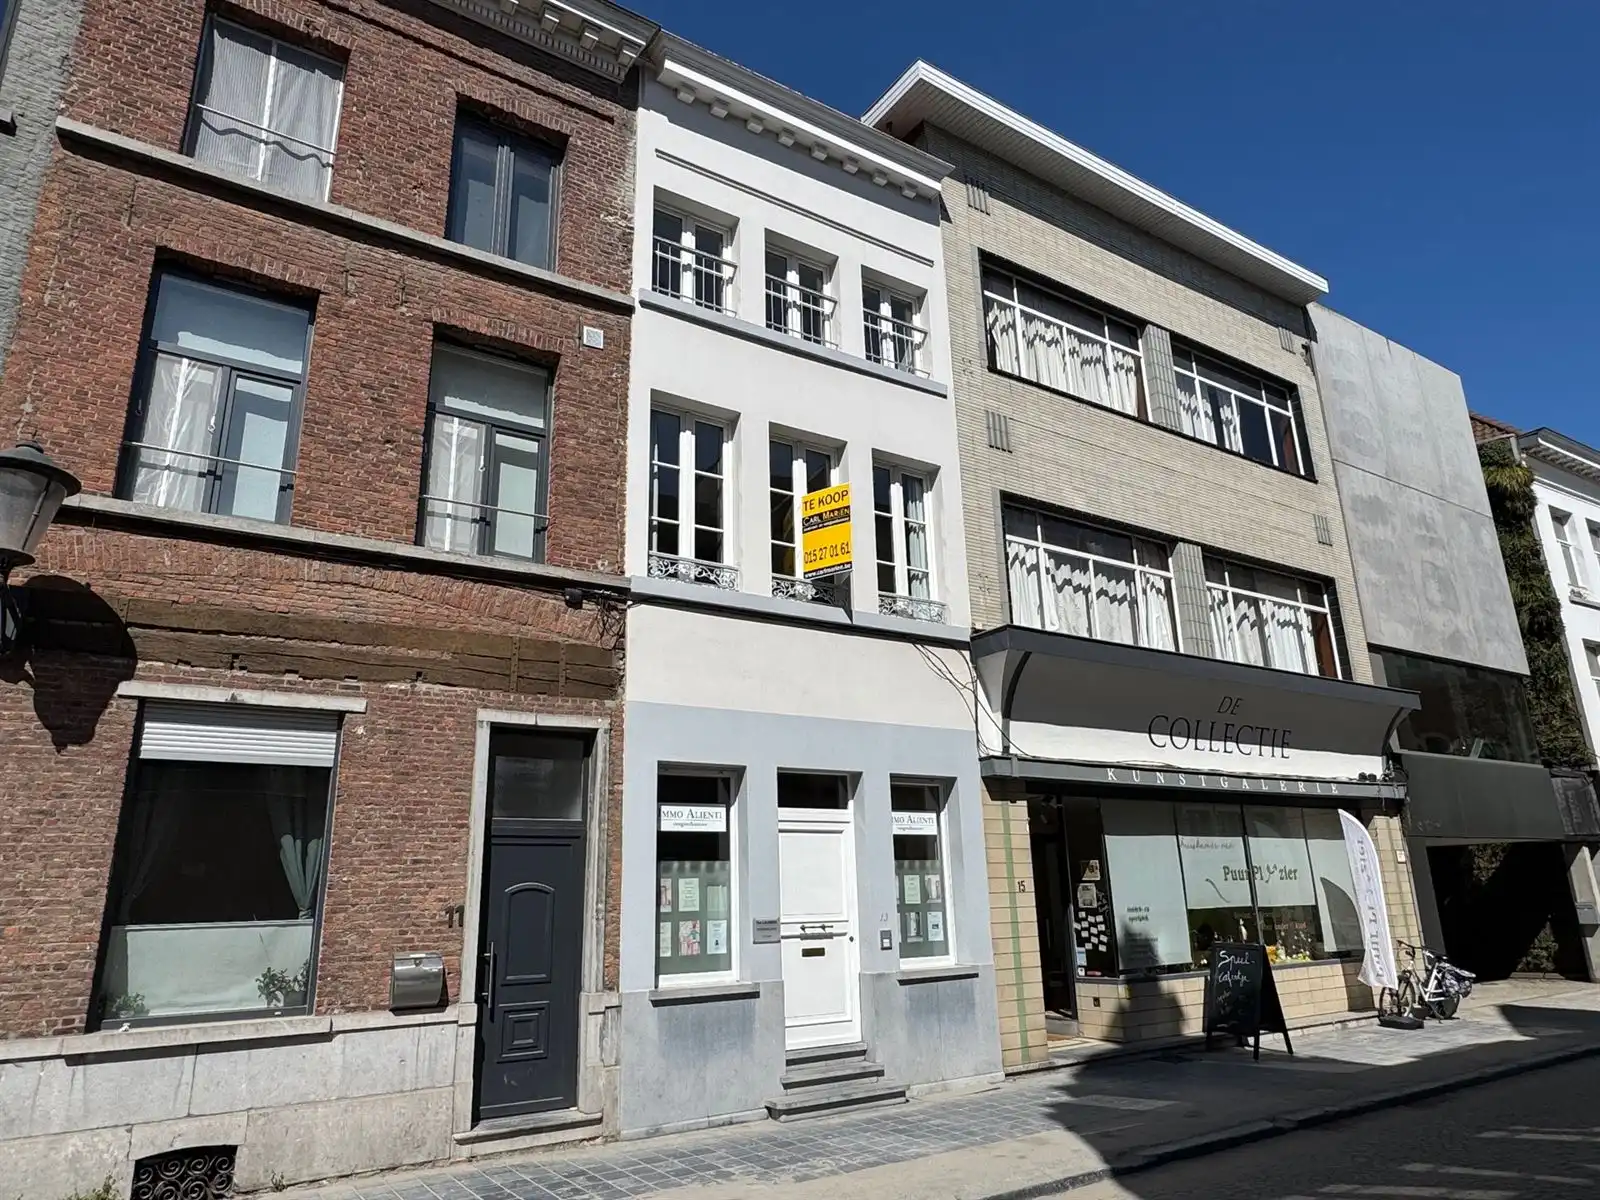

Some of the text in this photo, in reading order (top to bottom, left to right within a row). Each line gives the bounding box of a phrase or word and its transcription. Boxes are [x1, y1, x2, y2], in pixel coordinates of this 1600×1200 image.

[804, 490, 849, 511] TE KOOP
[804, 541, 851, 564] 015 27 01 61
[1217, 696, 1245, 715] DE
[1148, 715, 1292, 759] COLLECTIE
[1107, 768, 1338, 794] KUNSTGALERIE
[661, 810, 684, 819] MMO
[1017, 880, 1026, 893] 15
[444, 905, 465, 928] 11
